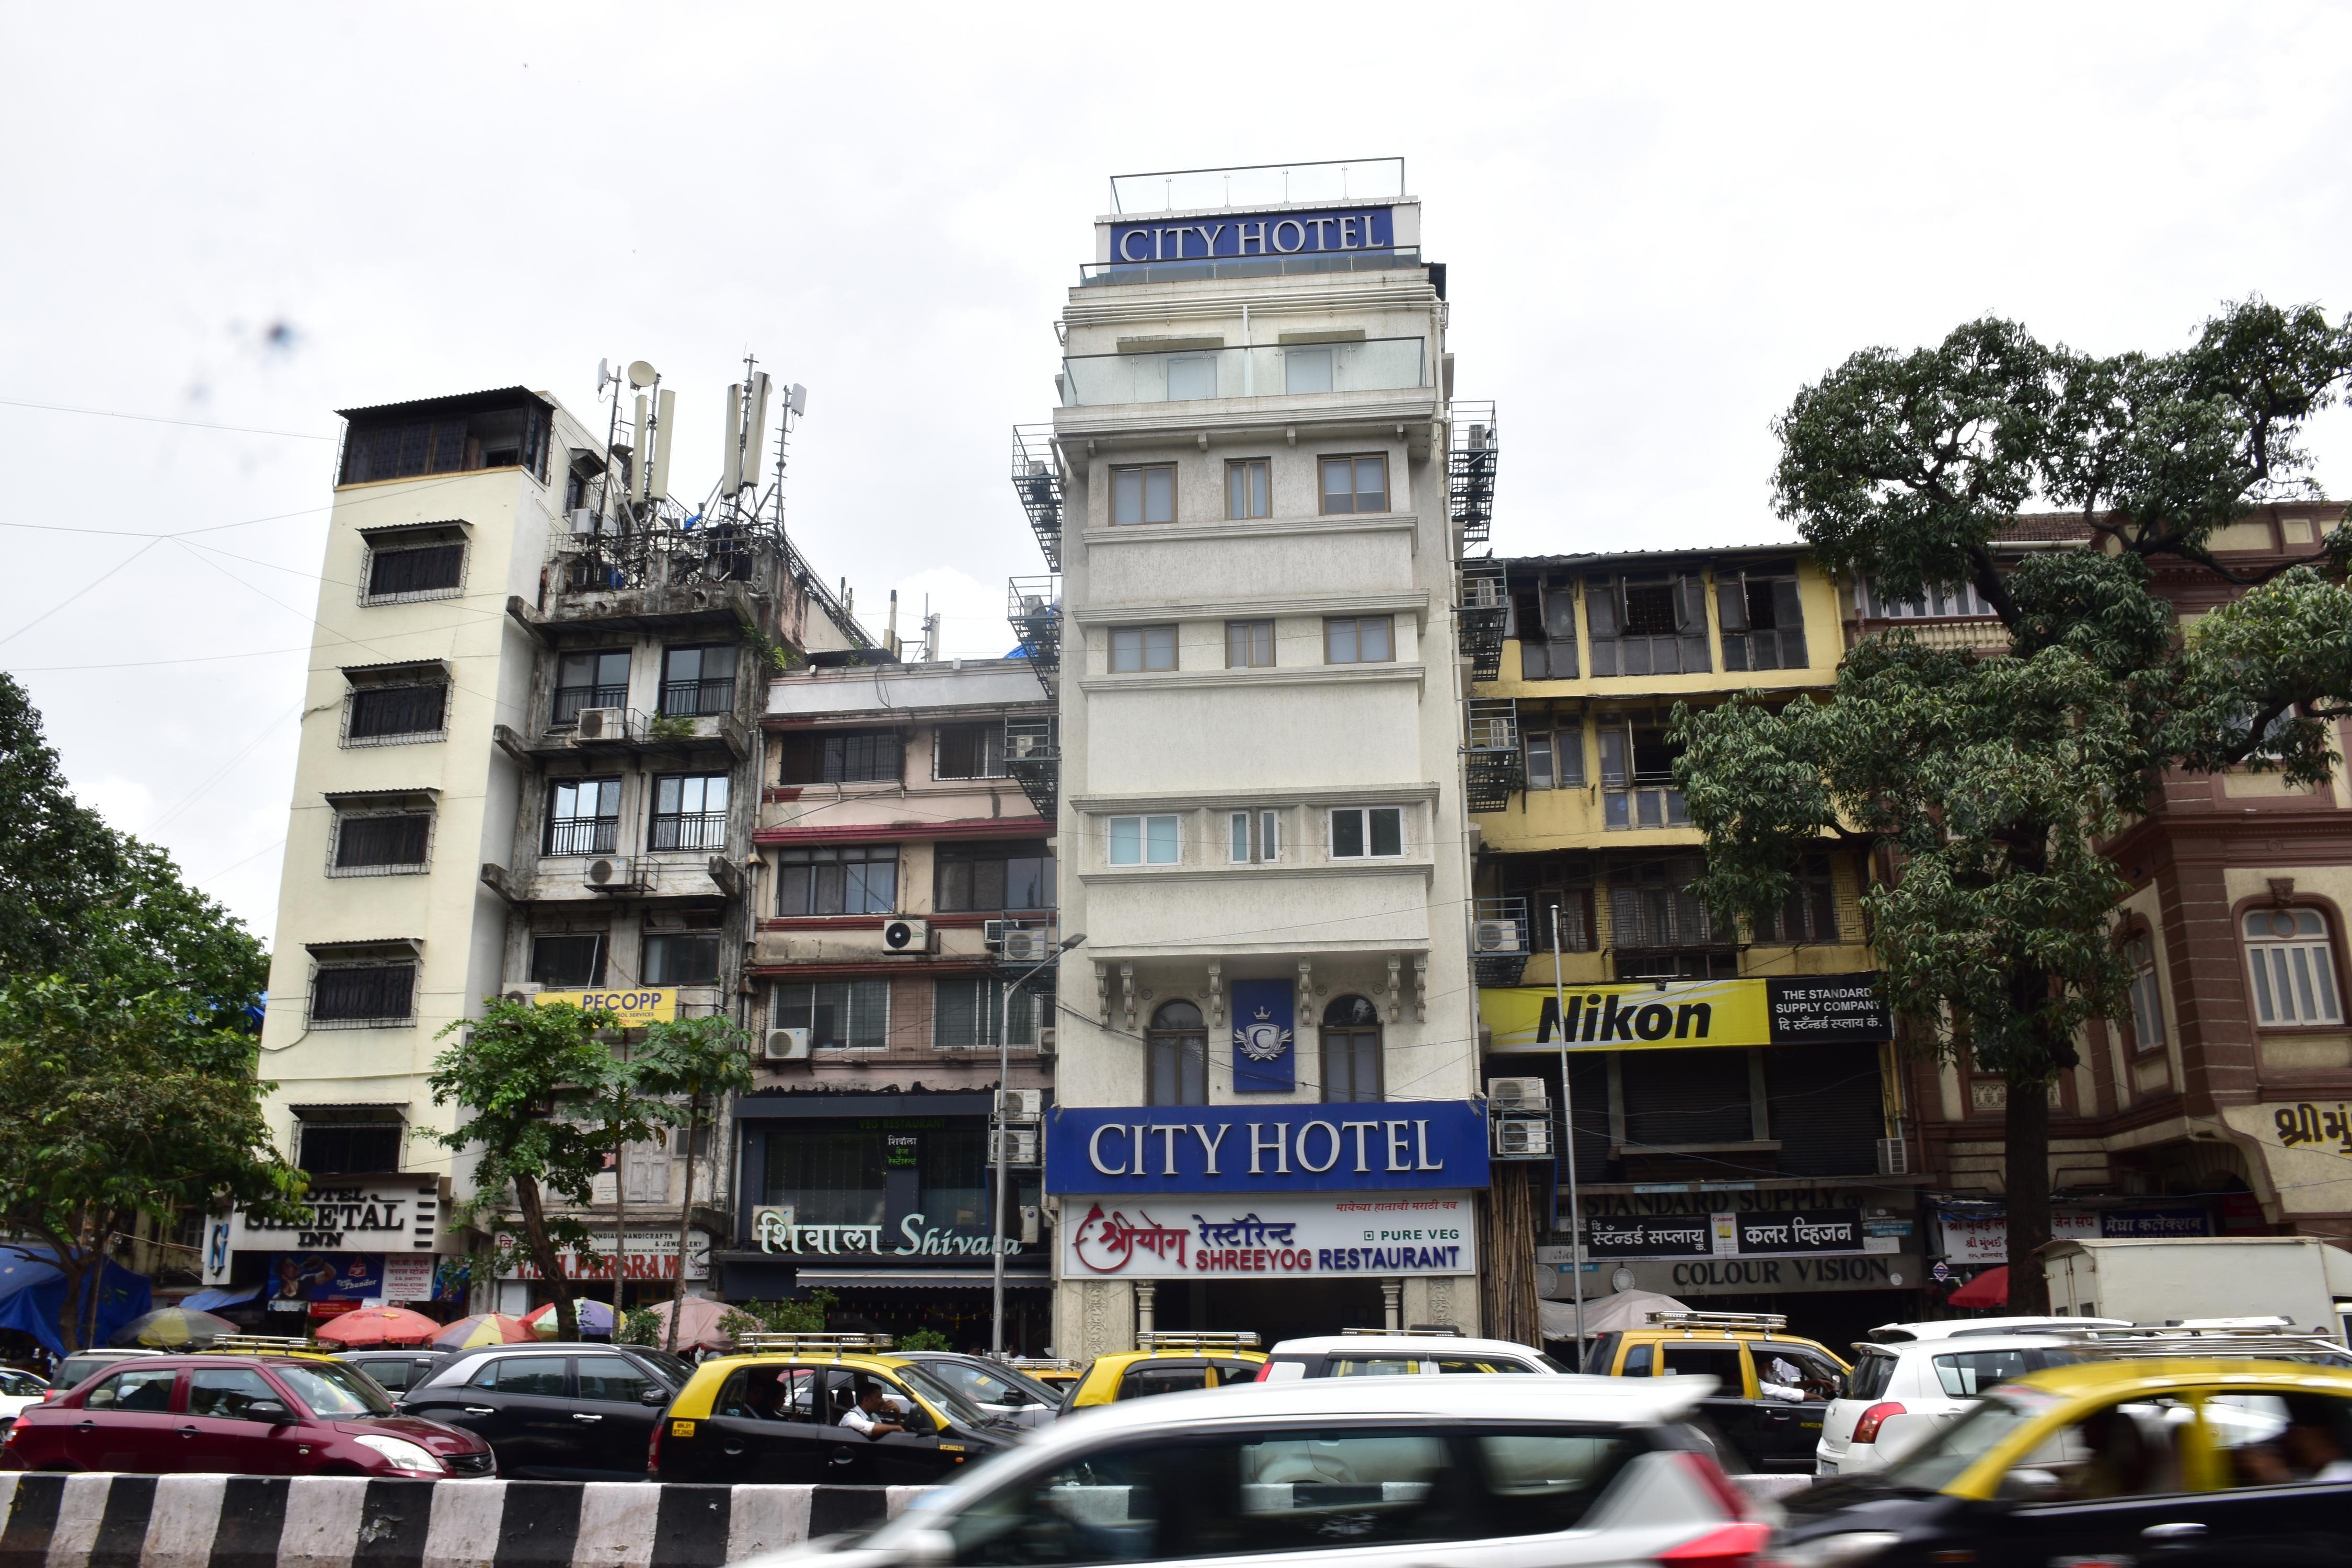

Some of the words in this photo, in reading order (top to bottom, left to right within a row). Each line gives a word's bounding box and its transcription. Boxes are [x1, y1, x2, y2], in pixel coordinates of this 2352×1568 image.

[1120, 224, 1225, 261] CITY
[1235, 215, 1383, 255] HOTEL
[582, 993, 662, 1011] PECOPP
[1782, 990, 1806, 1000] THE
[1809, 988, 1872, 999] STANDARD
[1776, 1002, 1820, 1013] SUPPLY
[1824, 1000, 1881, 1011] COMPANY
[1536, 993, 1712, 1044] Nikon
[1778, 1017, 1791, 1031] दि
[860, 1119, 879, 1129] VEG
[883, 1118, 946, 1129] RESTAURANT
[1089, 1123, 1231, 1176] CITY
[1247, 1119, 1444, 1174] HOTEL
[1374, 1200, 1410, 1213] हाताची
[1412, 1200, 1440, 1210] मराठी
[1585, 1191, 1728, 1215] STANDARD
[1738, 1187, 1838, 1211] SUPPLY
[297, 1231, 344, 1247] INN
[757, 1212, 883, 1254] शिवाला
[894, 1213, 1022, 1255] Shivaa
[1381, 1229, 1422, 1241] PURE
[1428, 1229, 1459, 1239] VEG
[1745, 1225, 1788, 1244] कलर
[1196, 1248, 1312, 1271] SHREEYOG
[1319, 1246, 1459, 1270] RESTAURANT
[1673, 1260, 1781, 1286] COLOUR
[1792, 1258, 1889, 1282] VISION
